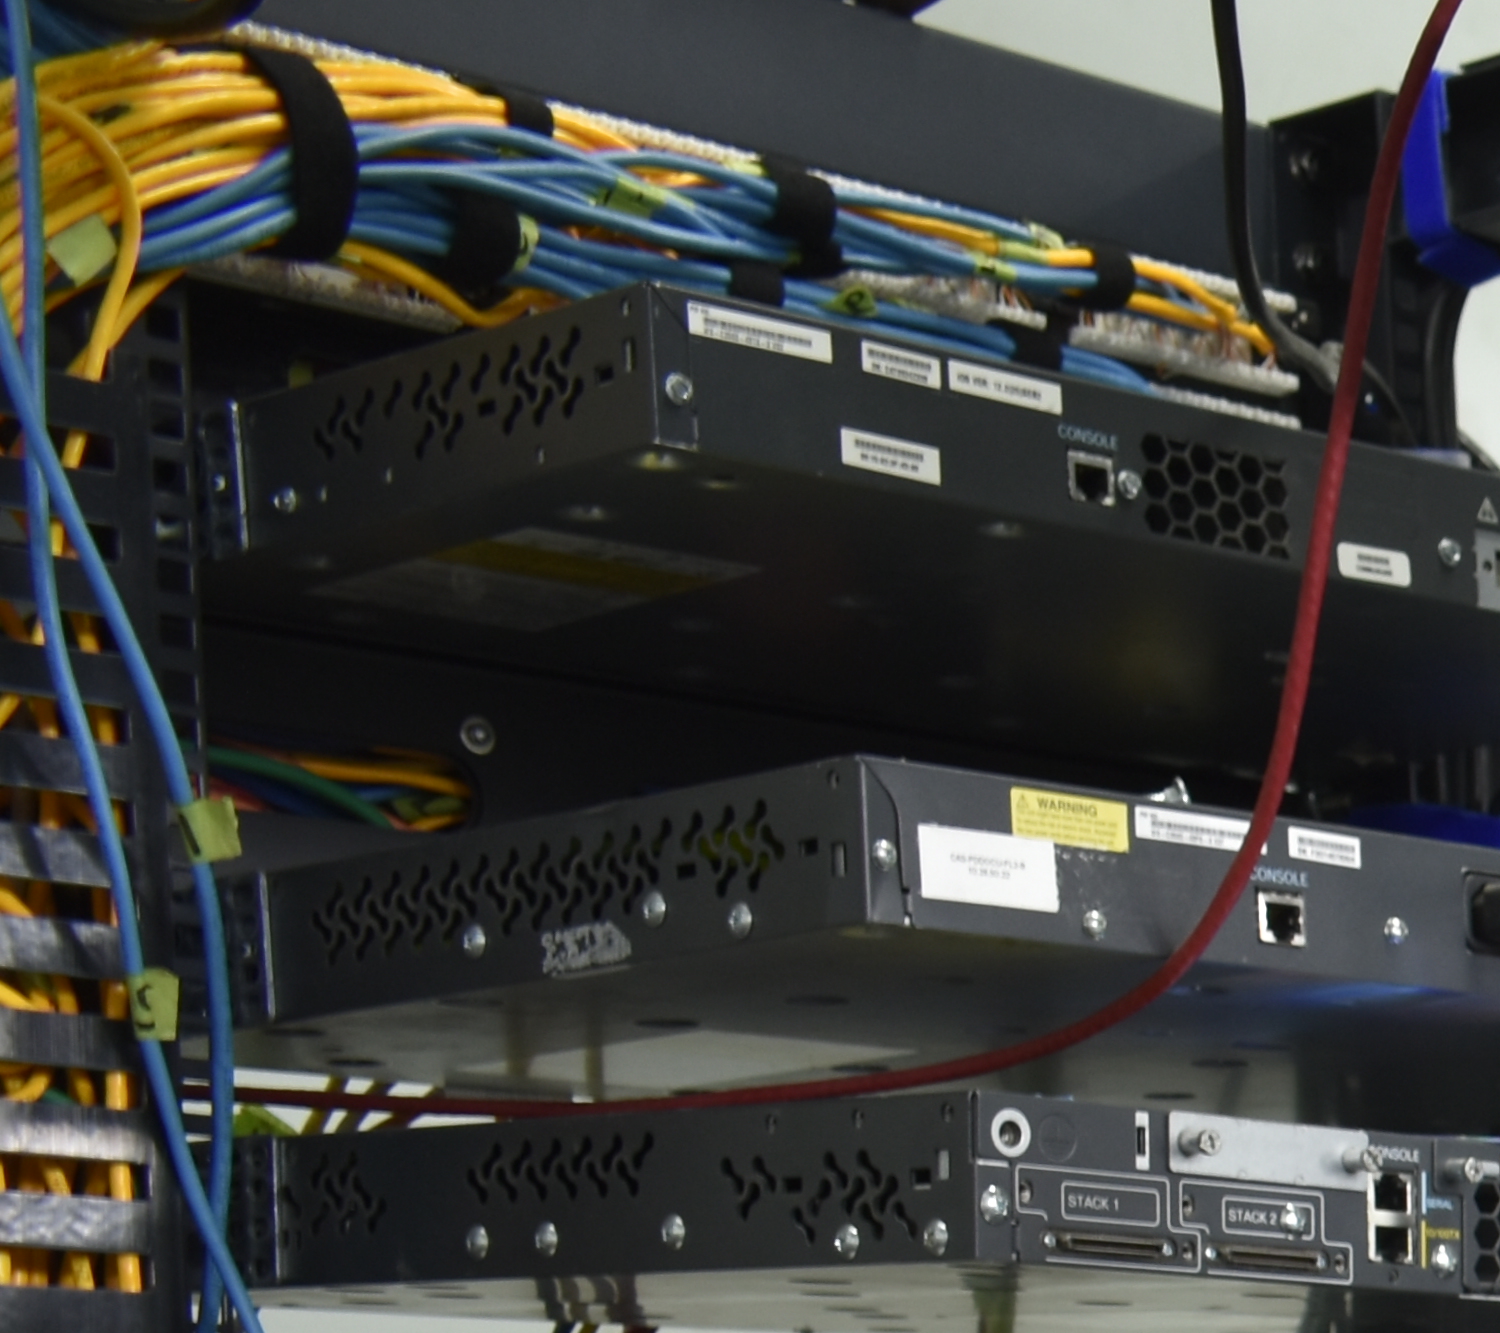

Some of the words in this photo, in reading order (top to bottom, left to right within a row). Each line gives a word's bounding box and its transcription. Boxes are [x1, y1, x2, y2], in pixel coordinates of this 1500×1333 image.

[1057, 423, 1119, 450] CONSOLE
[1036, 797, 1098, 818] WARNING
[1067, 1193, 1107, 1210] STACK
[1111, 1196, 1119, 1210] 1
[1228, 1207, 1265, 1225] STACK
[1267, 1211, 1277, 1225] 2
